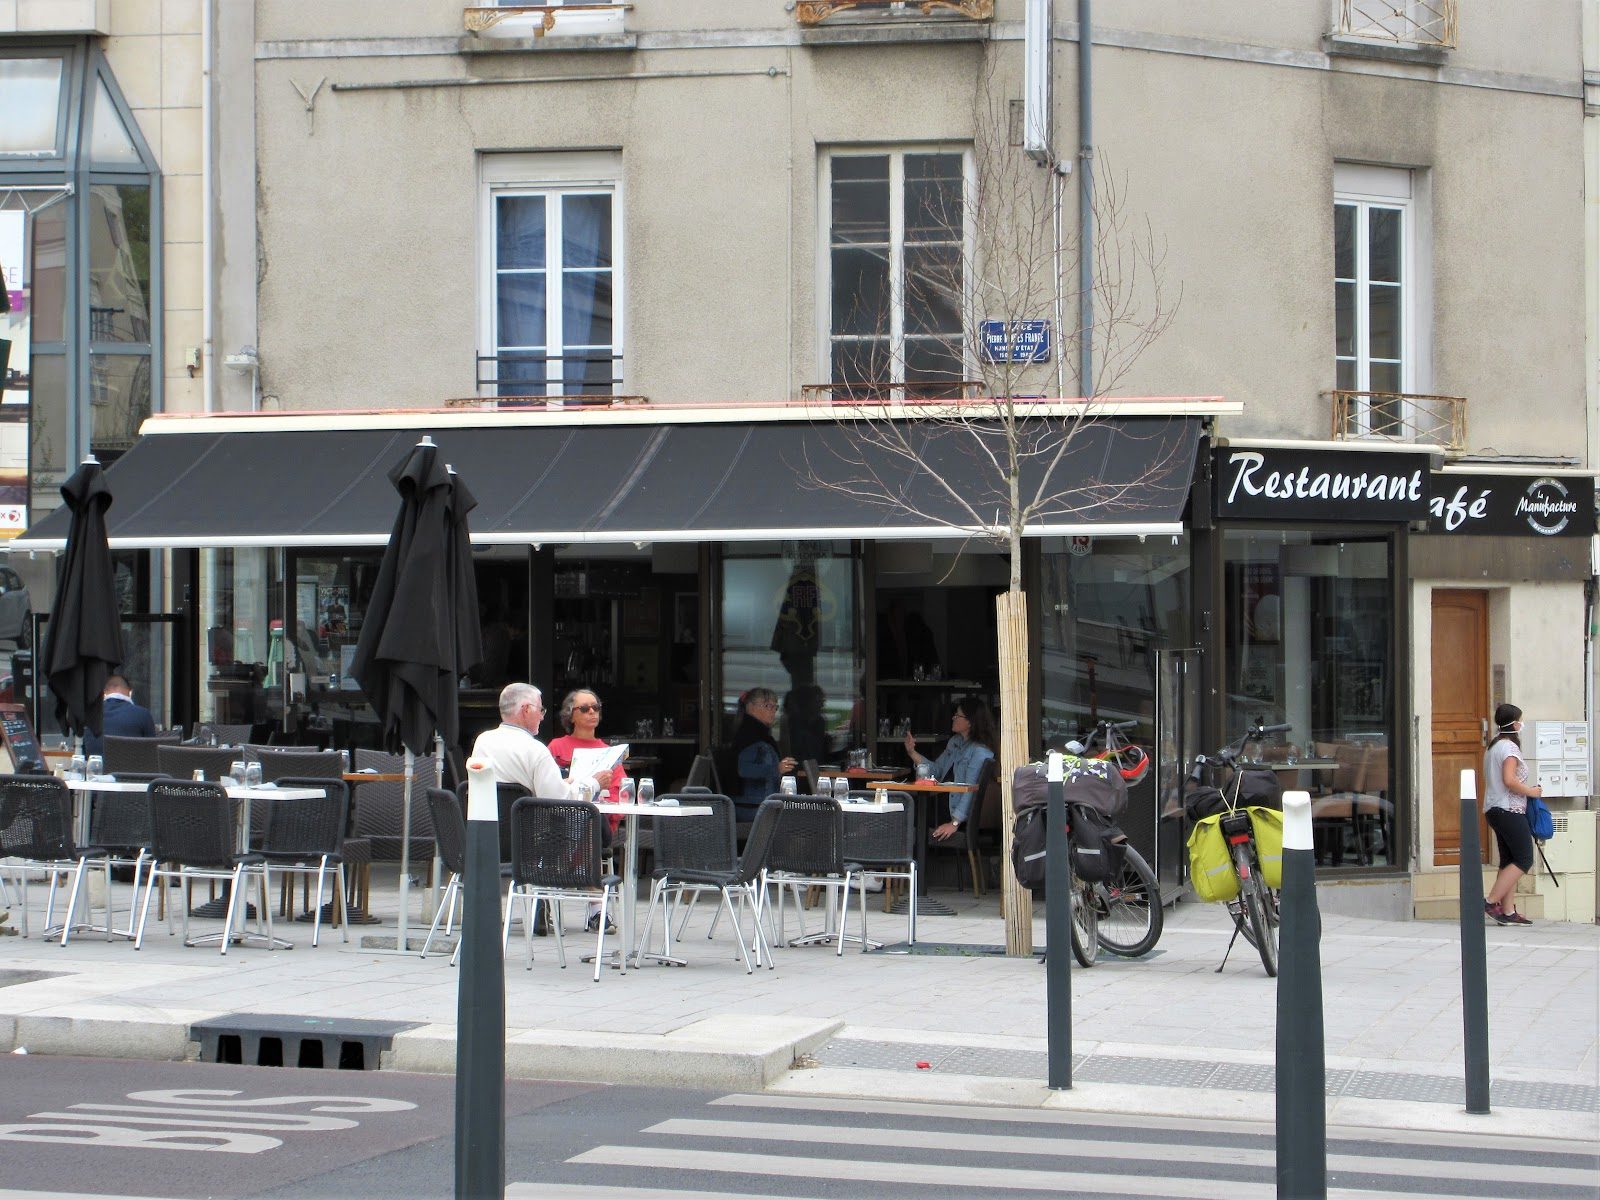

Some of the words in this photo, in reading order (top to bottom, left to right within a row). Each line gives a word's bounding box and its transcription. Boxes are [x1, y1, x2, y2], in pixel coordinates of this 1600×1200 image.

[1228, 452, 1421, 503] Restaurant
[1430, 486, 1492, 531] afé
[1515, 496, 1577, 518] Manufacture
[1537, 490, 1544, 499] La
[1532, 522, 1563, 534] Brasserie
[0, 1089, 419, 1154] BUS
